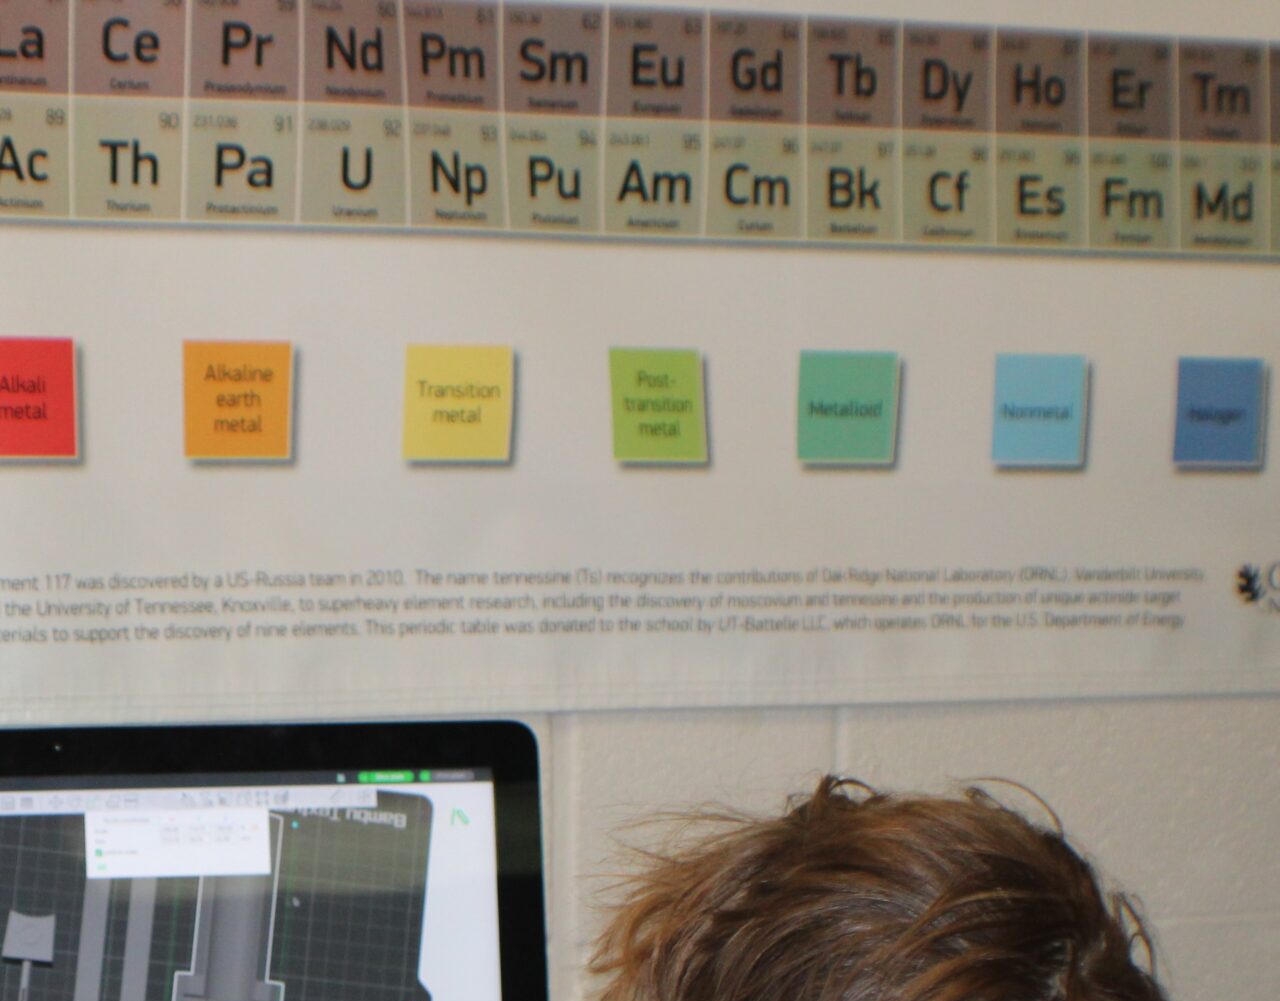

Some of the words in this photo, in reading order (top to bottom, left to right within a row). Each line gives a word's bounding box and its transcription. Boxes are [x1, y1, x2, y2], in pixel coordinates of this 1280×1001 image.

[102, 16, 160, 62] Ce
[222, 20, 273, 66] Pr
[326, 25, 384, 71] Nd
[422, 32, 485, 78] Pm
[520, 37, 588, 83] Sm
[633, 43, 684, 87] Eu
[732, 47, 784, 92] Gd
[828, 51, 877, 97] Tb
[924, 58, 974, 113] Dy
[1014, 62, 1065, 105] Ho
[1113, 67, 1153, 109] Er
[1193, 71, 1251, 114] Tm
[46, 107, 64, 125] 89
[159, 112, 179, 129] 90
[274, 115, 293, 133] 91
[383, 118, 402, 137] 92
[99, 137, 159, 186] Th
[216, 142, 273, 188] Pa
[341, 145, 373, 191] U
[431, 148, 488, 206] Np
[529, 154, 581, 199] Pu
[618, 158, 692, 203] Am
[727, 162, 790, 207] Cm
[829, 166, 881, 210] Bk
[931, 169, 970, 212] Cf
[1019, 174, 1065, 216] Es
[1105, 177, 1164, 219] Fm
[1195, 180, 1253, 222] Md
[203, 364, 273, 383] Alkaline
[418, 380, 500, 399] Transition
[637, 370, 676, 388] Post-
[216, 390, 261, 408] earth
[432, 406, 482, 423] metal
[624, 396, 692, 413] transition
[214, 415, 262, 433] metal
[639, 420, 680, 437] metal
[46, 573, 71, 590] 117
[76, 577, 104, 590] was
[108, 573, 188, 589] discovered
[192, 572, 208, 591] by
[214, 576, 223, 587] a
[309, 573, 346, 587] team
[350, 573, 362, 586] in
[416, 569, 442, 585] The
[446, 572, 488, 585] name
[493, 570, 571, 585] tennessine
[576, 567, 602, 585] (Ts)
[607, 570, 684, 588] recognizes
[689, 569, 713, 584] the
[806, 567, 818, 582] of
[886, 567, 939, 581] National
[943, 567, 1015, 585] Laboratory
[4, 599, 31, 616] the
[36, 599, 110, 618] University
[115, 598, 129, 614] of
[135, 598, 218, 615] Tennessee,
[298, 597, 314, 612] to
[403, 594, 464, 609] element
[608, 593, 631, 608] the
[637, 592, 704, 611] discovery
[710, 592, 722, 607] of
[53, 627, 68, 641] to
[73, 627, 129, 643] support
[135, 624, 159, 640] the
[164, 622, 231, 641] discovery
[237, 621, 251, 637] of
[256, 622, 287, 637] nine
[366, 619, 395, 635] This
[399, 619, 455, 639] periodic
[460, 619, 499, 634] table
[504, 621, 534, 633] was
[539, 617, 595, 633] donated
[599, 617, 613, 632] to
[619, 617, 640, 632] the
[646, 616, 692, 632] school
[697, 616, 713, 635] by
